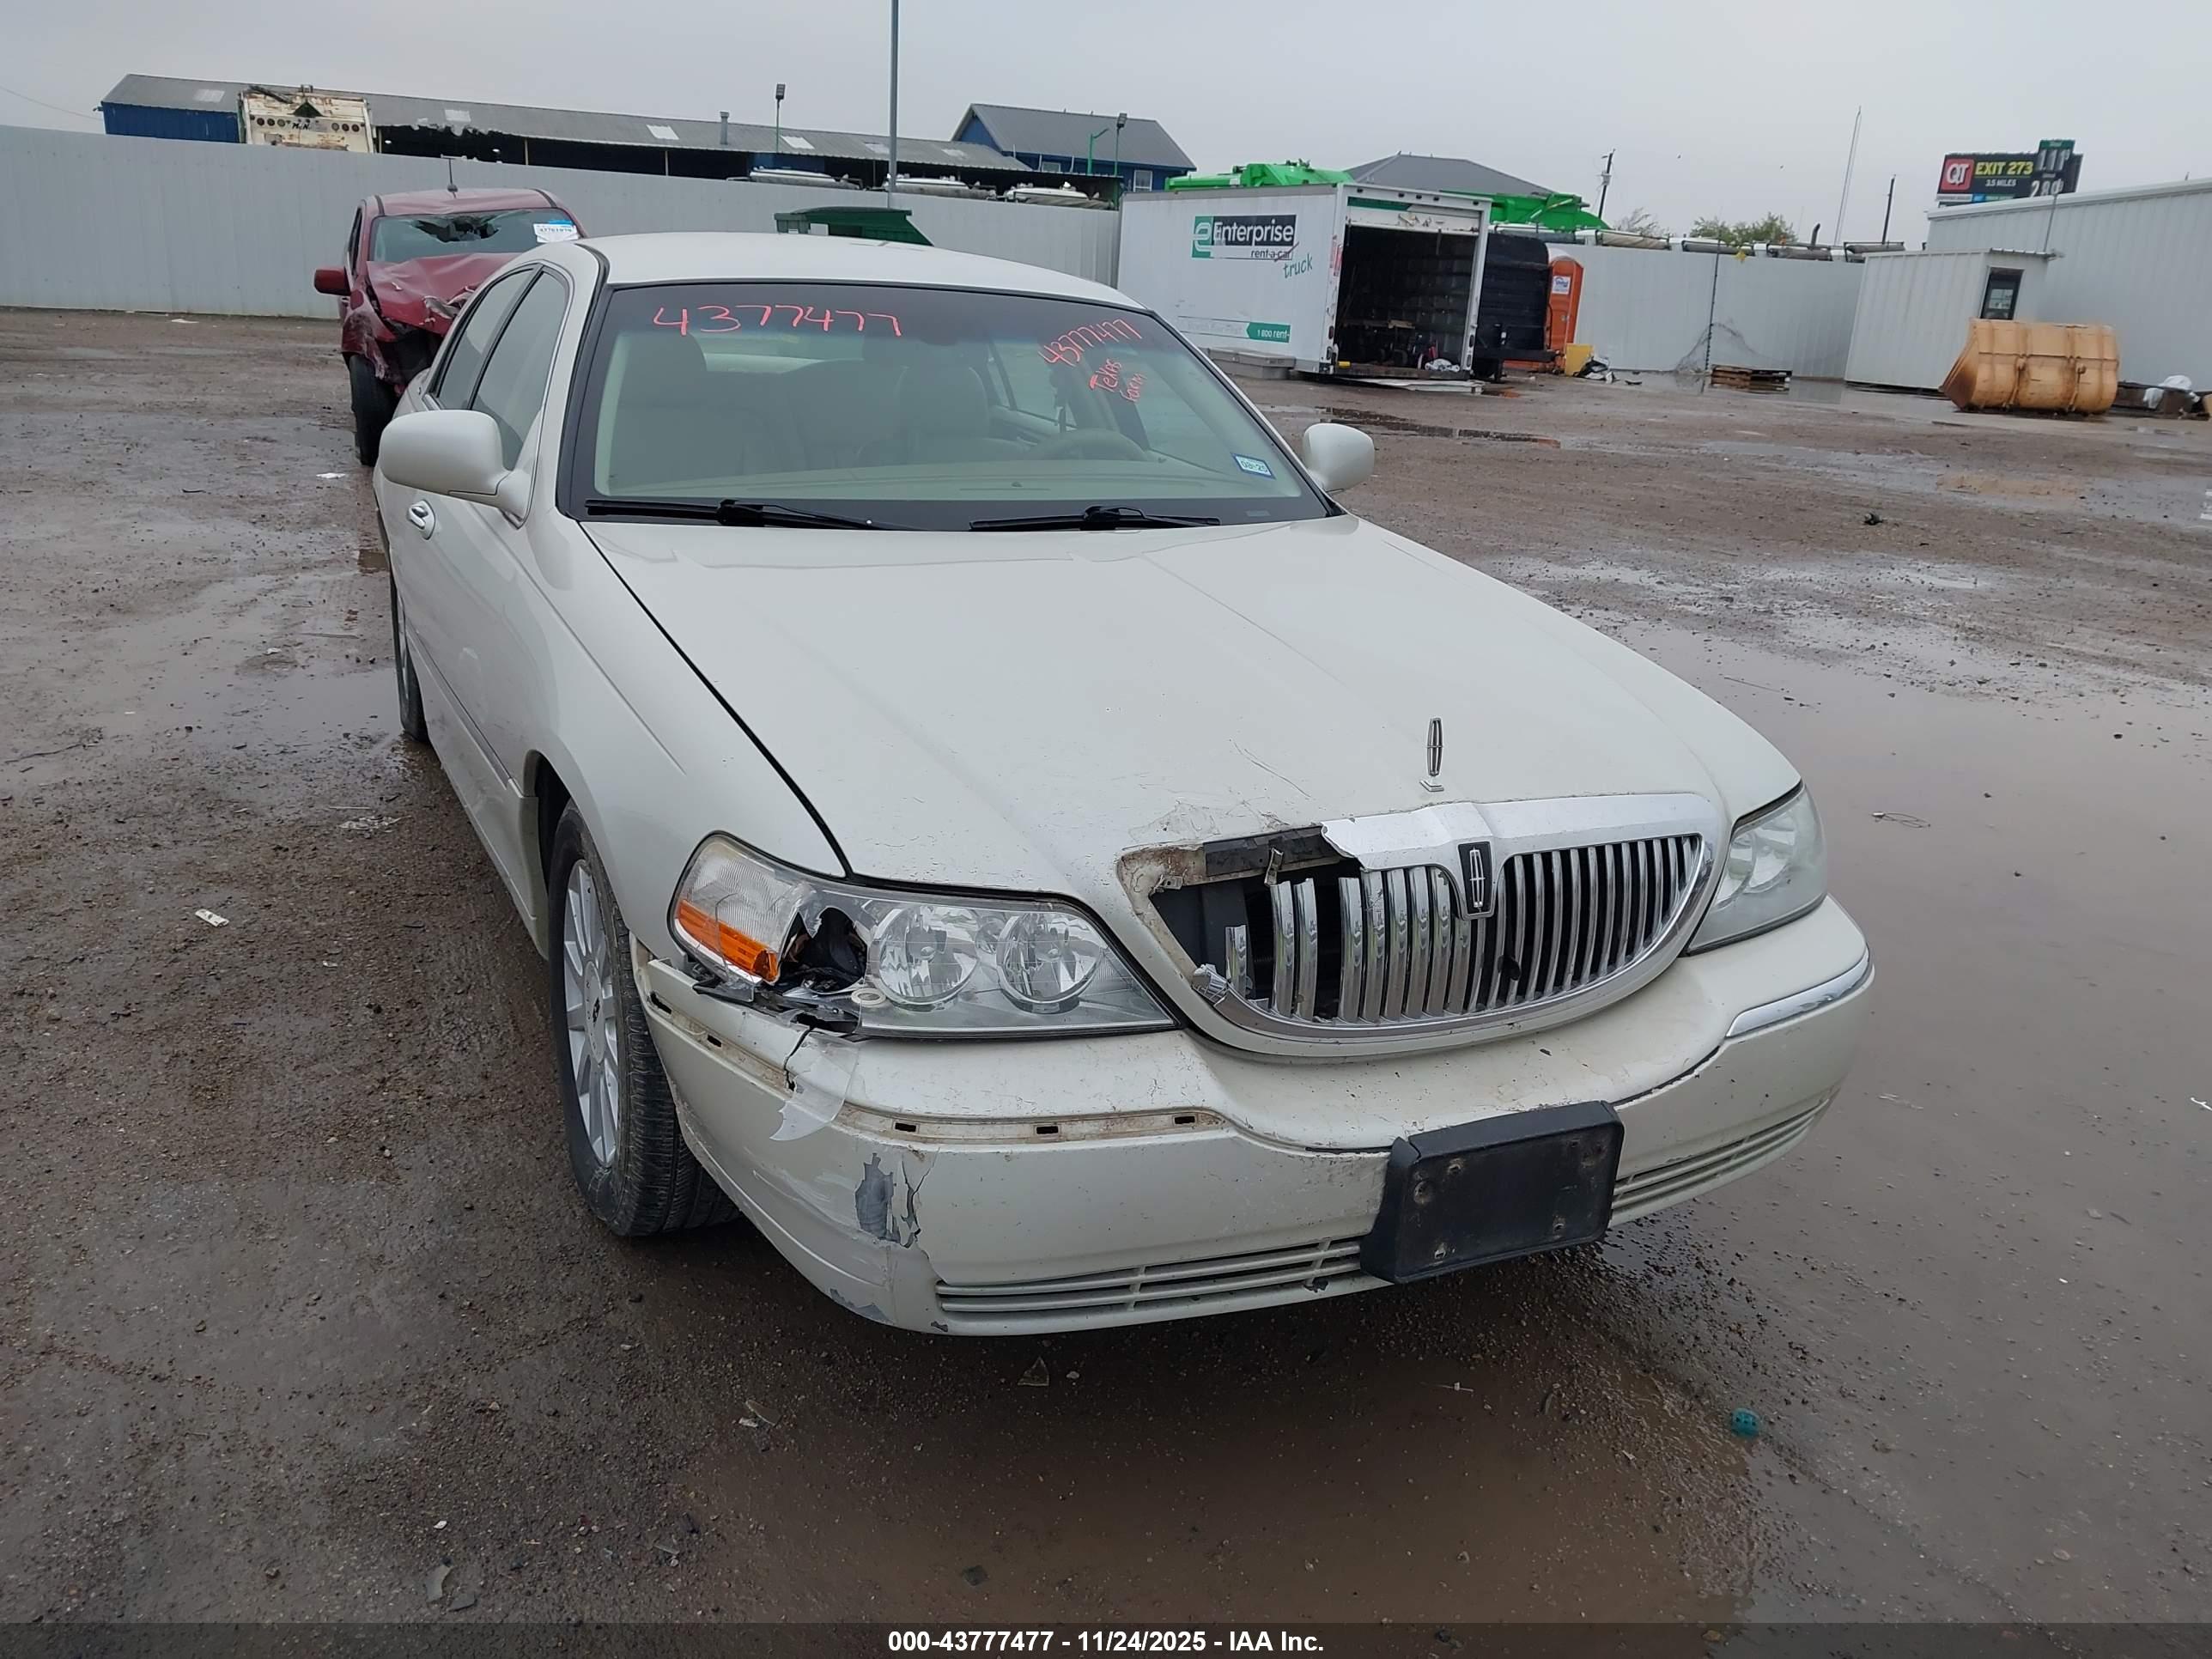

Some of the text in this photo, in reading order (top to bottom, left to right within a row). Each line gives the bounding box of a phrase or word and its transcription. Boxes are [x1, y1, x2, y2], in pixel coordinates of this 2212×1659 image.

[1947, 163, 1969, 185] QT
[1975, 161, 2033, 175] EXIT 273
[1213, 218, 1294, 246] Enterprise
[1283, 253, 1313, 279] truck
[653, 305, 902, 337] 4377477
